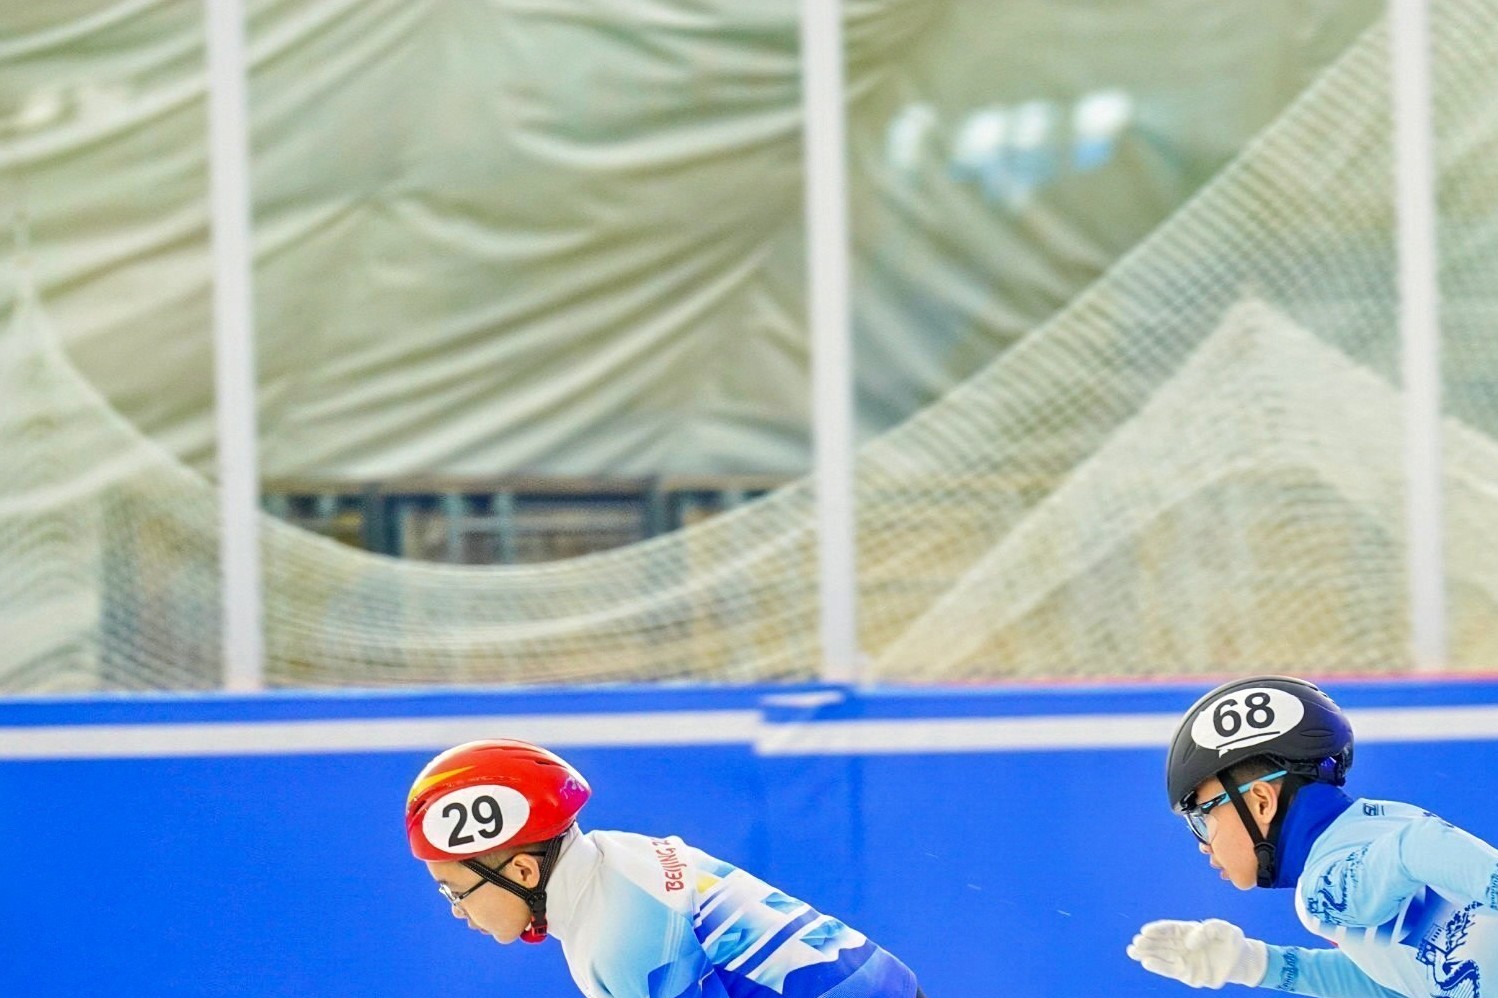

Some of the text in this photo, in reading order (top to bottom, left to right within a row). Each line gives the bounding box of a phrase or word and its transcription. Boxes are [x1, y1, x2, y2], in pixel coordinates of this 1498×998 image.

[1213, 692, 1275, 737] 68
[442, 795, 504, 847] 29
[655, 847, 687, 892] BEIJING
